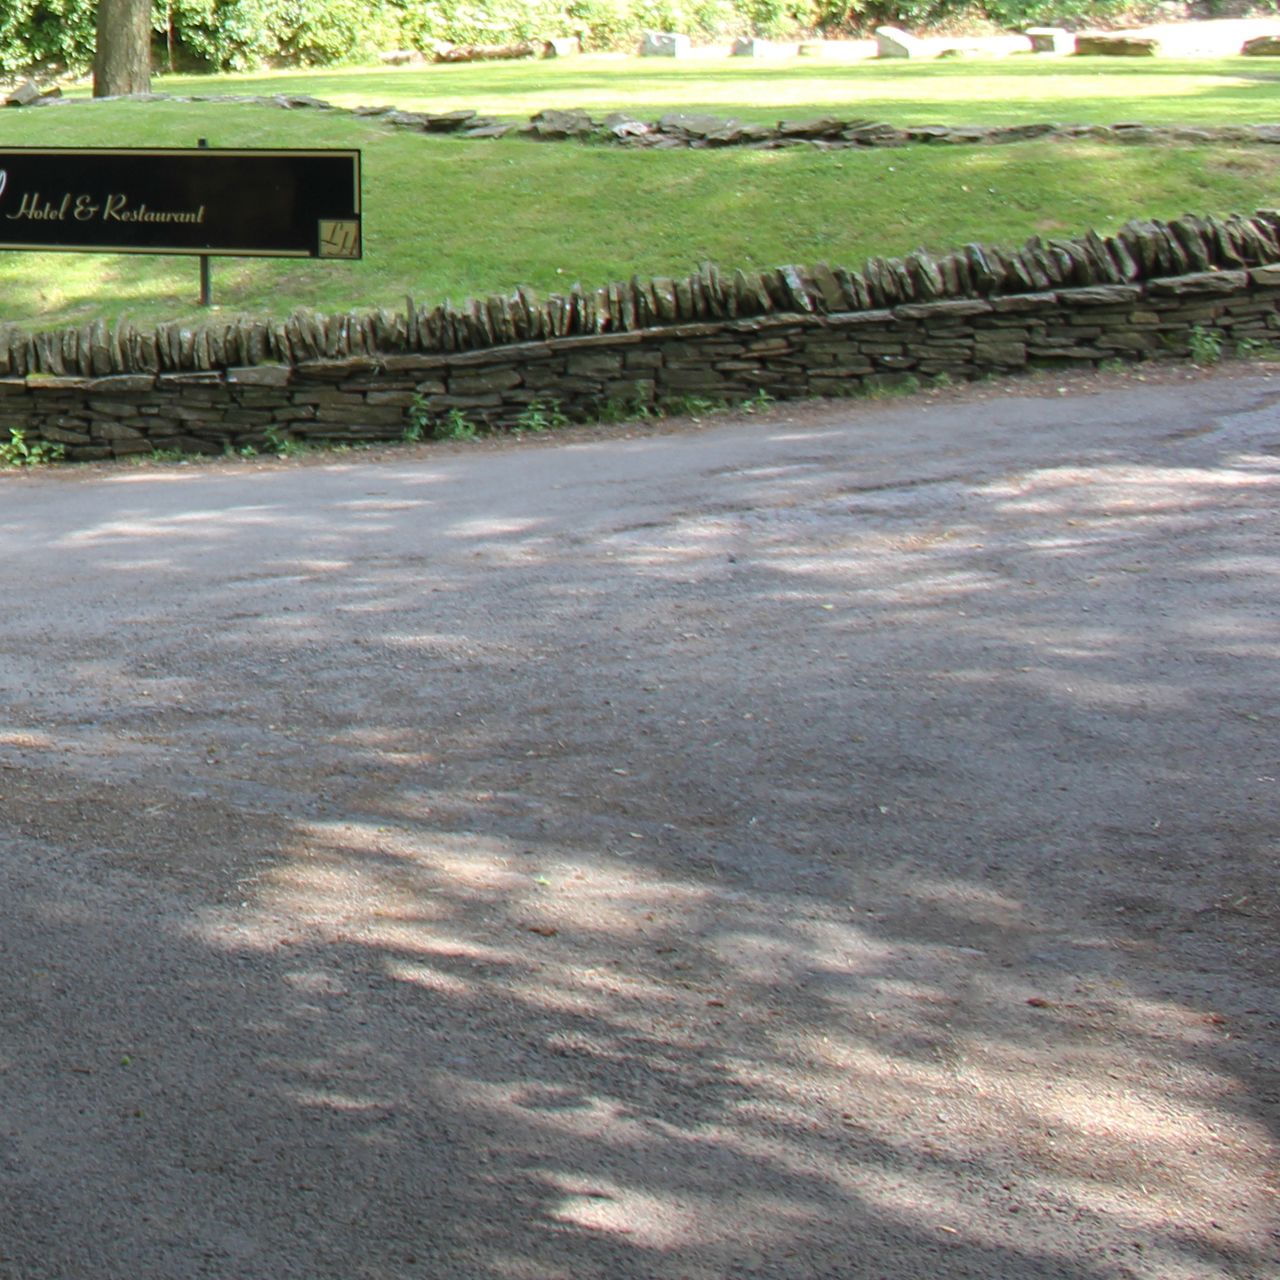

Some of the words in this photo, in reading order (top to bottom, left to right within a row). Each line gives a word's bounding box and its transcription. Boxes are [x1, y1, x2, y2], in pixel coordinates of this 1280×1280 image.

[6, 192, 71, 220] Hotel
[73, 195, 99, 220] &
[103, 194, 205, 223] Restaurant
